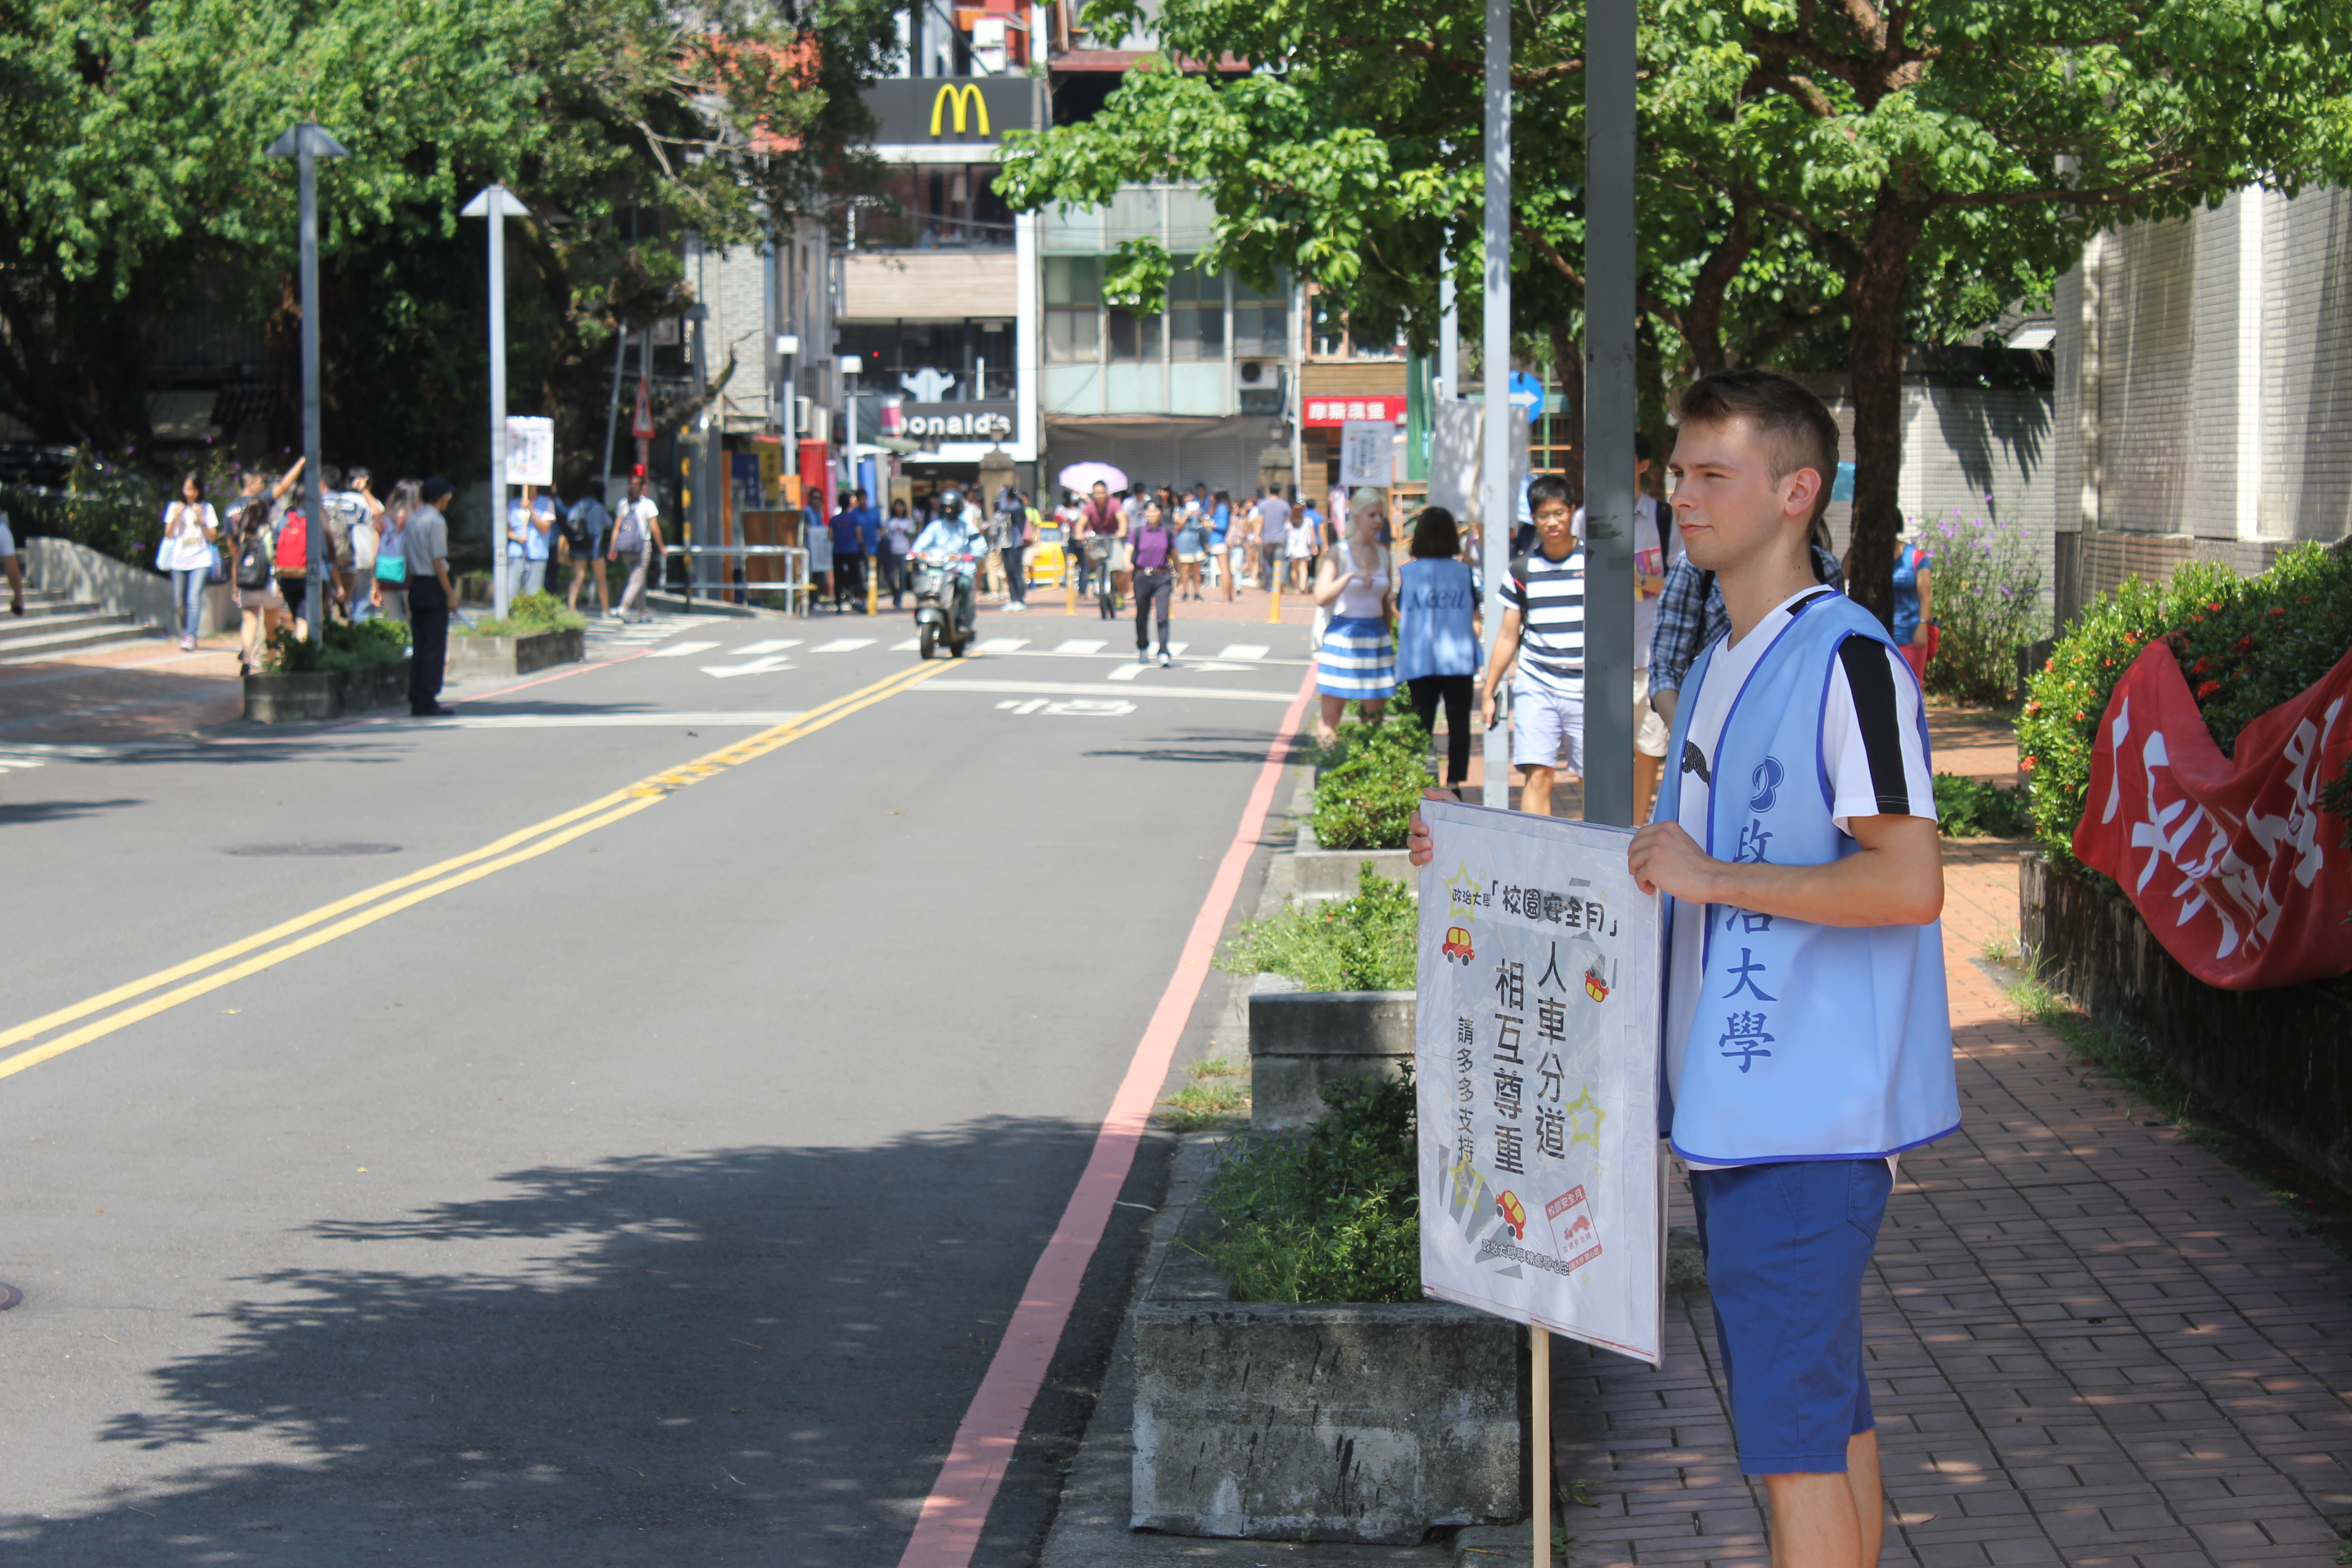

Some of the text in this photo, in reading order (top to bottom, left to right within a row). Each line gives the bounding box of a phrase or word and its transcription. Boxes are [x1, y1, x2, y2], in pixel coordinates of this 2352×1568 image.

[1456, 1016, 1475, 1164] 請多多支持
[1493, 958, 1525, 1176] 相互尊重
[1535, 941, 1567, 1160] 人車分道
[1548, 1188, 1583, 1217] 校園安全月
